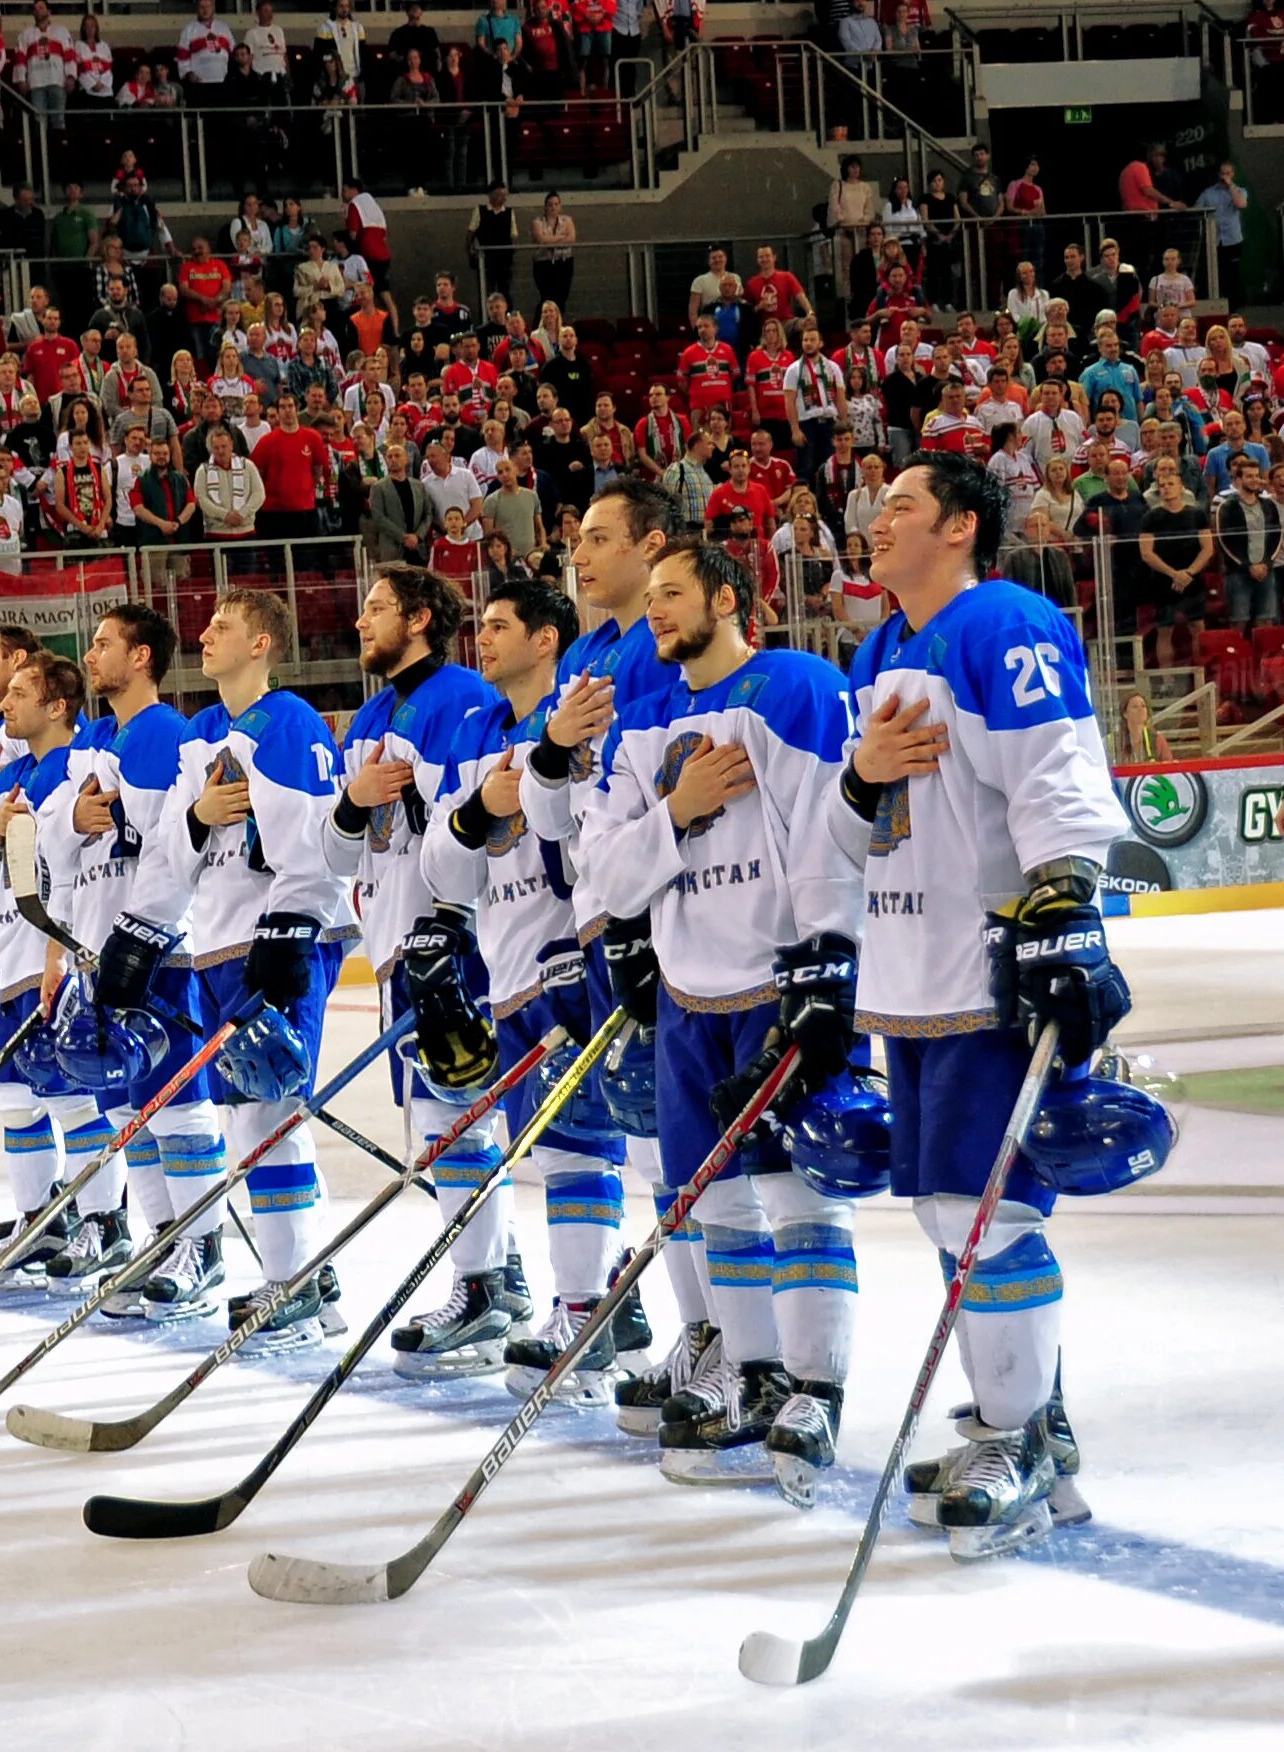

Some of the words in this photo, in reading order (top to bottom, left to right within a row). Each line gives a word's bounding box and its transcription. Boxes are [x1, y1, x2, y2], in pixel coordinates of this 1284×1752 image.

[1175, 125, 1205, 147] 220
[1183, 153, 1205, 172] 114
[1004, 641, 1062, 707] 26
[774, 961, 851, 988] CCM
[416, 1078, 514, 1168] VAPOR
[660, 1124, 745, 1230] VAPOR
